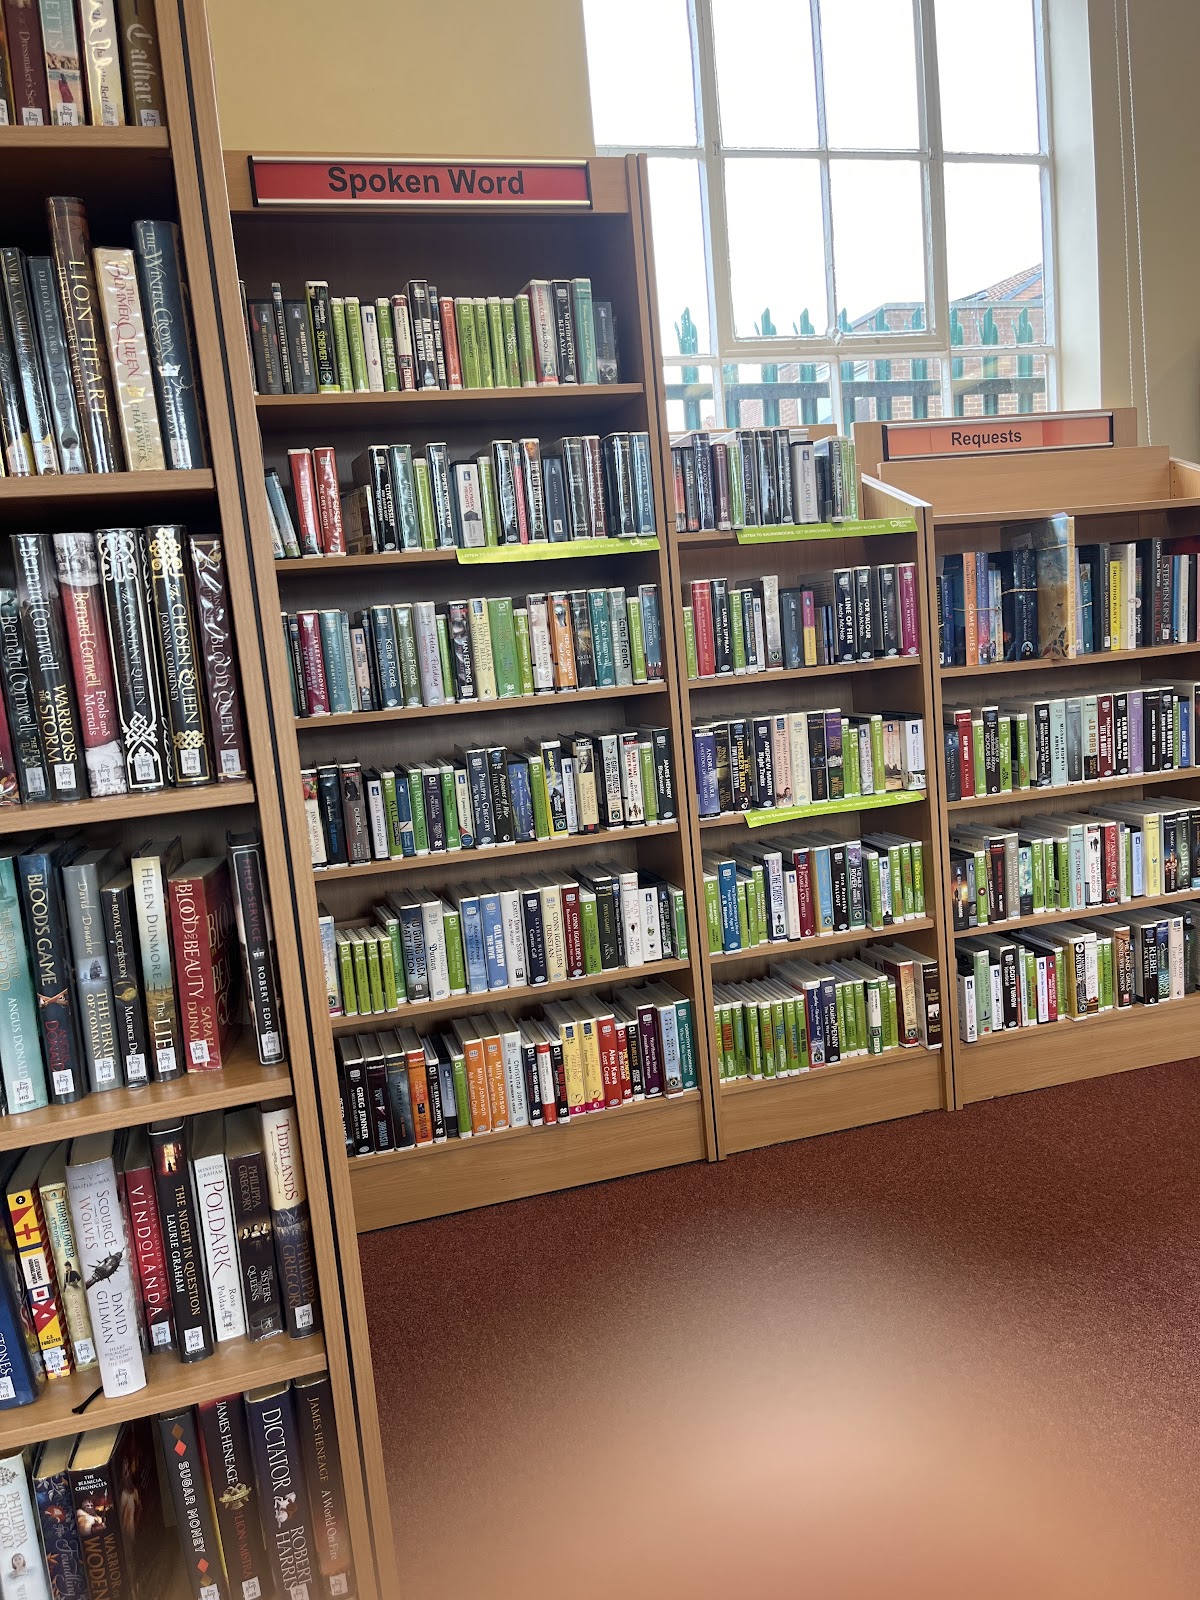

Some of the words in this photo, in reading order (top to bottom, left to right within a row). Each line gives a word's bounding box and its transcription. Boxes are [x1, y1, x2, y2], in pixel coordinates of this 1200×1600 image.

[19, 32, 36, 88] Dressmaker's
[127, 23, 152, 103] Cathar
[329, 166, 440, 199] Spoken
[447, 169, 525, 195] Word
[144, 248, 172, 305] WINTER
[38, 270, 54, 323] DEBORAH
[47, 326, 59, 354] CARR
[68, 260, 90, 321] LION
[81, 337, 108, 418] HEART
[151, 307, 174, 359] CROWN
[316, 331, 328, 361] SCHEMER
[424, 333, 435, 362] Cleeves
[558, 319, 566, 356] BETRAYAL
[52, 361, 64, 387] Mrs
[64, 315, 86, 409] CARTWRIGHT
[131, 402, 148, 463] CHADWICK
[142, 412, 153, 454] ELIZABETH
[951, 429, 1022, 446] Requests
[20, 547, 45, 606] Bernard
[1162, 563, 1170, 600] STEPHEN
[73, 592, 96, 637] Bernard
[159, 611, 172, 648] JOANNA
[619, 617, 627, 637] Tana
[846, 616, 852, 625] OF
[1162, 601, 1170, 622] KING
[32, 608, 59, 671] Cornwell
[171, 603, 191, 665] CHOSEN
[385, 638, 393, 659] Katie
[405, 636, 413, 657] Katie
[80, 640, 101, 687] Cornwell
[123, 604, 141, 667] CONSTANT
[133, 668, 146, 706] QUEEN
[210, 635, 232, 687] BLOOD
[620, 640, 630, 669] French
[0, 615, 24, 670] Bernard
[14, 672, 40, 733] Cornwell
[164, 651, 180, 702] COURTNEY
[95, 690, 108, 719] Fools
[178, 668, 200, 723] QUEEN
[54, 684, 78, 762] WARRIORS
[84, 694, 99, 736] Mortals
[100, 720, 110, 736] and
[214, 690, 236, 745] QUEEN
[39, 705, 62, 763] STORM
[478, 773, 487, 801] PHILIPPA
[492, 773, 500, 796] HILARY
[657, 765, 665, 794] Blackwater
[664, 778, 672, 798] HENRY
[481, 802, 491, 832] GREGORY
[494, 798, 503, 820] GREEN
[242, 859, 255, 892] FIELD
[1181, 843, 1189, 877] OSIRIS
[28, 873, 51, 936] BLOOD'S
[76, 880, 90, 910] David
[141, 867, 155, 910] HELEN
[110, 904, 122, 929] ROYAL
[174, 884, 201, 934] BLOOD
[247, 895, 262, 942] SERVICE
[552, 912, 560, 930] CONN
[571, 913, 579, 930] CONN
[145, 915, 162, 979] DUNMORE
[403, 922, 412, 944] MATT
[493, 924, 502, 939] GILL
[546, 924, 554, 958] DUNSTAN
[573, 930, 582, 960] IGGULDEN
[37, 937, 57, 986] GAME
[114, 930, 128, 978] SUCCESSION
[405, 945, 414, 975] HILTON
[416, 957, 426, 978] BACK
[438, 951, 447, 981] HINGLEY
[495, 940, 504, 967] HORNBY
[554, 932, 563, 968] IGGULDEN
[1148, 946, 1156, 979] REBEL
[183, 940, 204, 999] BEAUTY
[257, 966, 270, 1004] ROBERT
[7, 997, 22, 1033] ANGUS
[123, 1006, 136, 1041] MAURICE
[156, 1001, 167, 1017] The
[200, 1006, 214, 1046] SARAH
[44, 1020, 66, 1072] DONALD
[58, 1028, 70, 1064] ANGUS
[153, 1019, 173, 1048] LIE
[723, 1023, 733, 1051] HAUNTED
[830, 1025, 838, 1048] PENNY
[13, 1035, 29, 1079] DONALD
[494, 1061, 503, 1080] Milly
[513, 1060, 521, 1090] Christina
[476, 1068, 484, 1087] Milly
[610, 1066, 618, 1085] Kava
[357, 1086, 365, 1108] GREG
[478, 1088, 487, 1116] Johnson
[498, 1083, 506, 1114] Johnson
[359, 1110, 368, 1139] JENNER
[197, 1163, 224, 1176] WINSTON
[199, 1169, 224, 1179] GRAHAM
[274, 1118, 298, 1201] TIDELANDS
[174, 1185, 187, 1207] THE
[237, 1165, 253, 1212] GREGORY
[248, 1165, 261, 1207] PHILIPPA
[78, 1195, 98, 1251] WOLVES
[97, 1190, 118, 1249] SCOURGE
[147, 1194, 158, 1229] ADRIAN
[177, 1210, 191, 1245] NIGHT
[202, 1179, 231, 1280] POLDARK
[50, 1217, 62, 1248] ATROPOS
[56, 1201, 75, 1259] HORNBLOWER
[166, 1214, 179, 1248] LAURIE
[130, 1185, 163, 1317] VINDOLANDA
[152, 1233, 168, 1303] GOLDSWORTHY
[184, 1247, 193, 1260] IN
[171, 1251, 185, 1293] GRAHAM
[183, 1262, 201, 1316] QUESTION
[246, 1265, 259, 1301] QUEENS
[281, 1243, 302, 1309] GREGORY
[294, 1239, 315, 1304] PHILIPPA
[111, 1292, 127, 1335] DAVID
[228, 1288, 238, 1307] Ross
[95, 1290, 115, 1345] GILMAN
[215, 1401, 232, 1433] JAMES
[307, 1397, 322, 1431] JAMES
[221, 1435, 239, 1484] HENEAGE
[260, 1407, 291, 1491] DICTATOR
[312, 1433, 328, 1482] HENEAGE
[178, 1461, 198, 1506] SUGAR
[322, 1489, 330, 1499] A
[5, 1491, 28, 1550] PHILIPPA
[186, 1509, 206, 1553] MONEY
[322, 1499, 336, 1527] World
[326, 1528, 338, 1543] On
[328, 1543, 338, 1561] Fire
[54, 1538, 81, 1596] Foundling
[103, 1534, 122, 1588] WARRIOR
[275, 1531, 299, 1591] HARRIS
[290, 1525, 313, 1586] ROBERT
